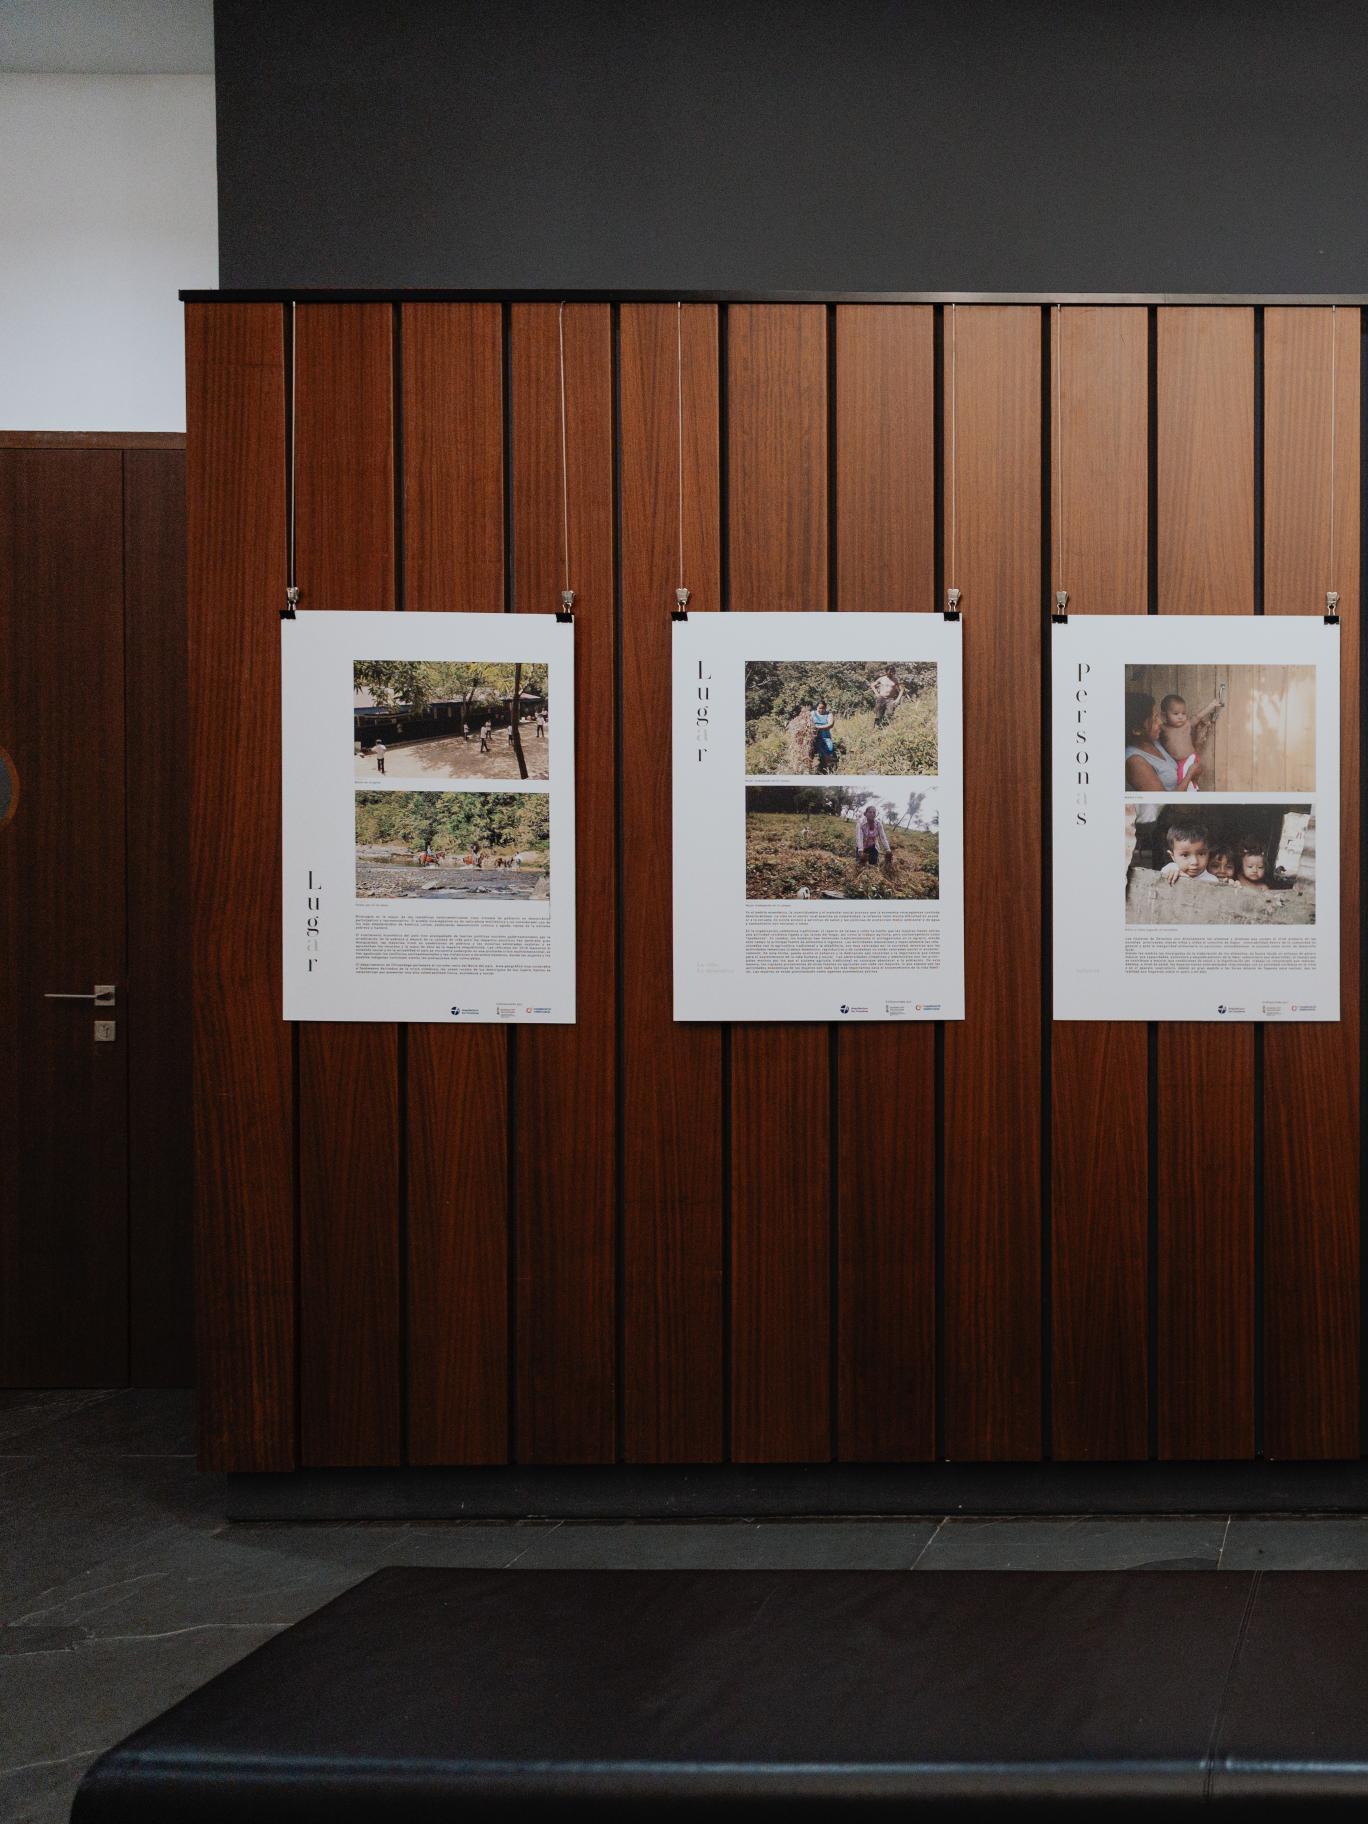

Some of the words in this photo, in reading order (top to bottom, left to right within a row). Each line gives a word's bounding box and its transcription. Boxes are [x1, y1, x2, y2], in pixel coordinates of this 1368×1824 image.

[696, 661, 712, 763] Lugar
[1075, 664, 1091, 825] Personas
[306, 871, 323, 973] Lugar
